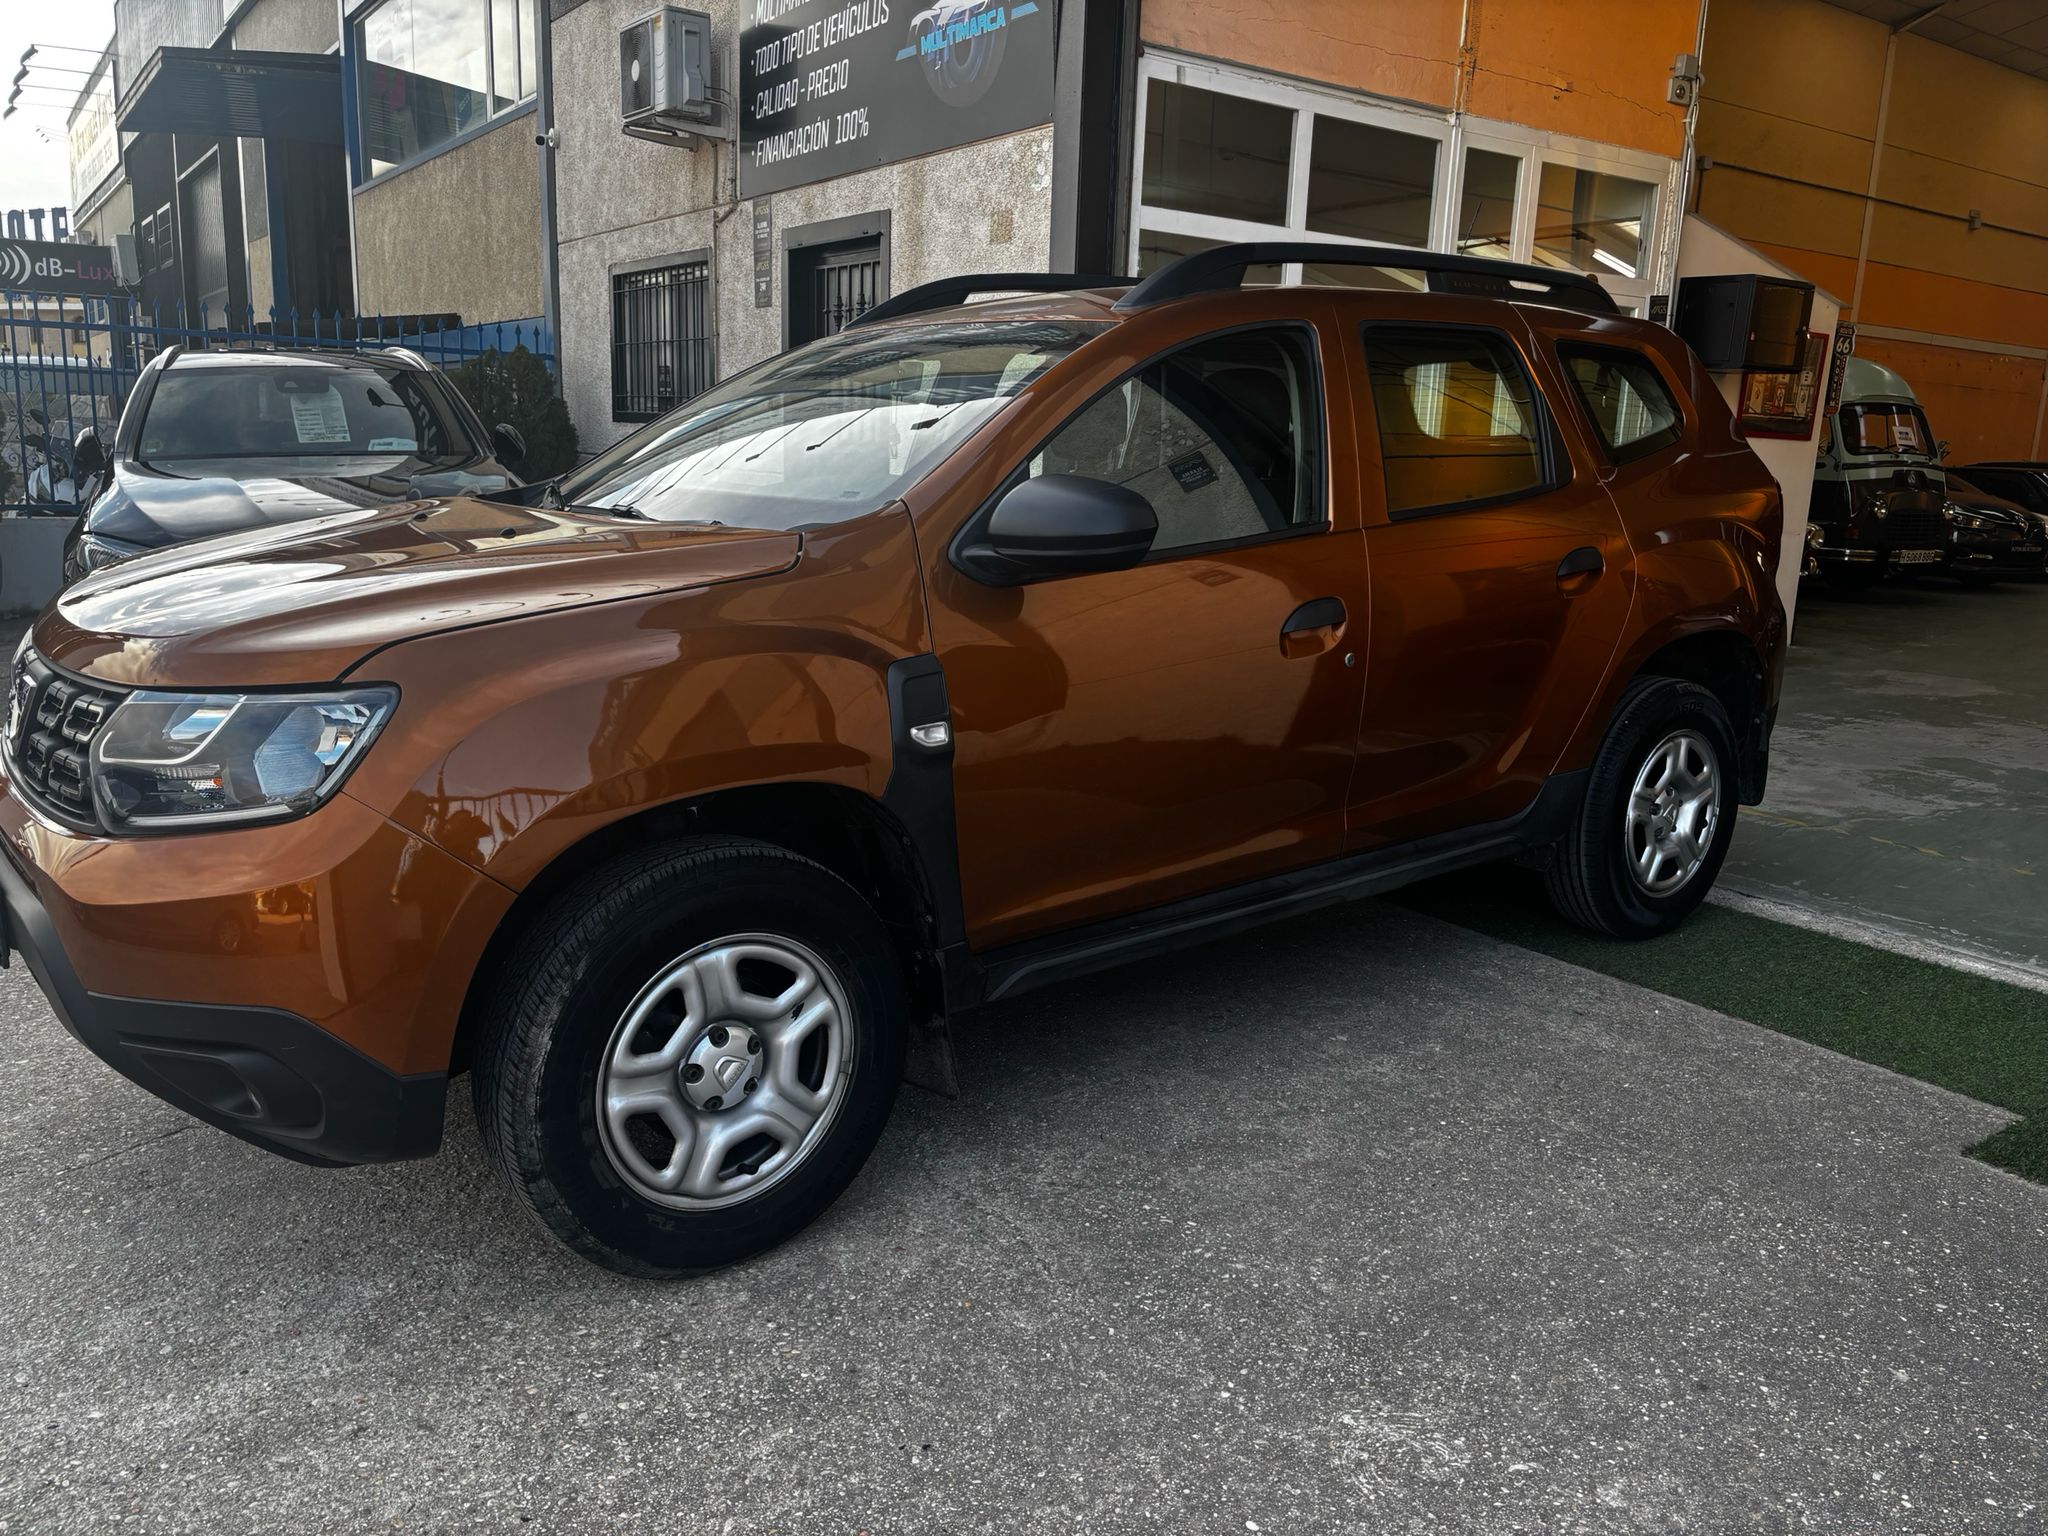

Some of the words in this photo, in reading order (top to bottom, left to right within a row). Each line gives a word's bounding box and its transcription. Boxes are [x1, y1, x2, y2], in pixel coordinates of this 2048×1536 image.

[755, 40, 780, 77] TODO
[782, 29, 805, 66] TIPO
[806, 21, 822, 56] DE
[823, 0, 890, 48] VEHÍCULOS
[920, 7, 1006, 56] MULTIMARCA
[755, 78, 799, 120] CALIDAD
[807, 58, 849, 102] PRECIO
[755, 116, 830, 168] FINANCIACIÓN
[835, 106, 869, 145] 100%
[34, 257, 115, 281] dB-Lux
[1836, 337, 1850, 354] 66
